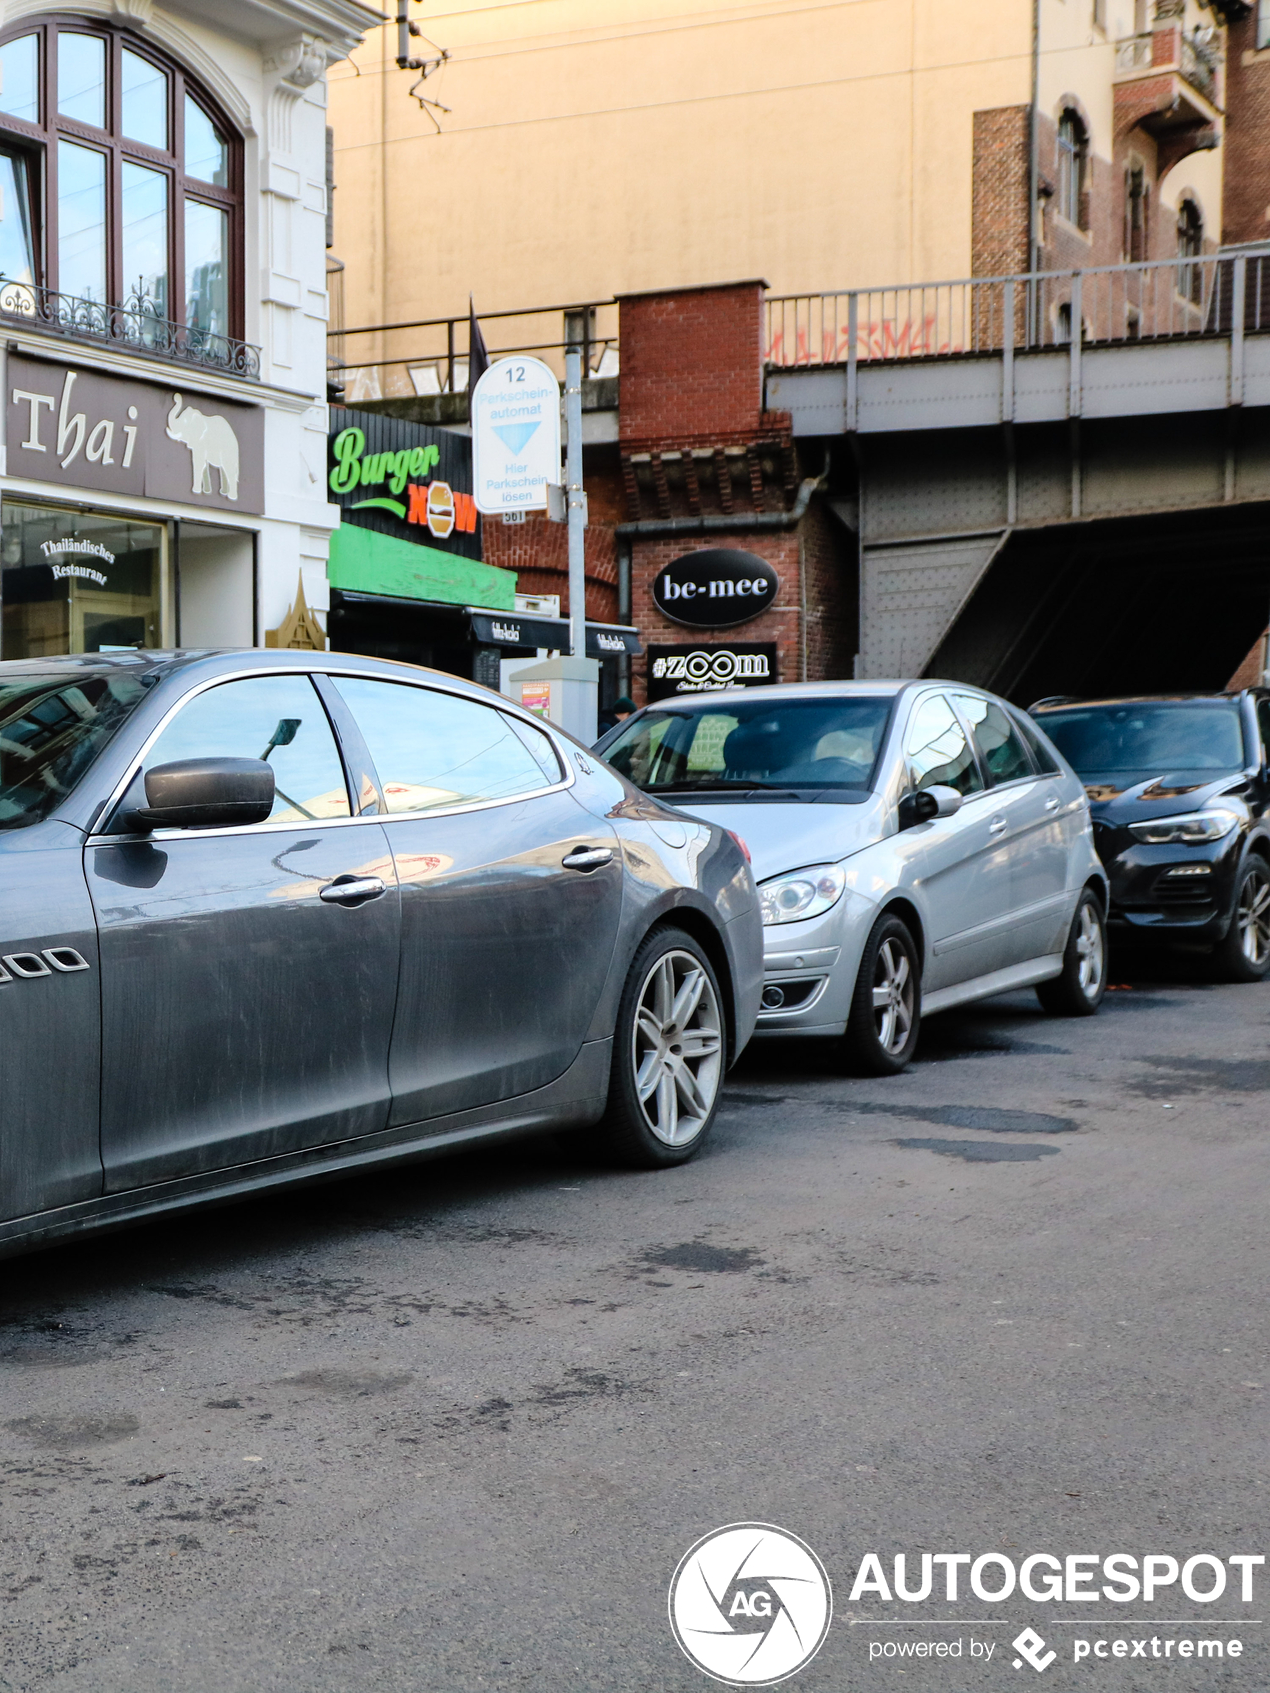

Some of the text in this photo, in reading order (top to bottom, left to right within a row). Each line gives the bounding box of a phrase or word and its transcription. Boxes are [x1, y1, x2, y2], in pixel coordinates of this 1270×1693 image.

[505, 366, 526, 383] 12
[480, 387, 553, 406] Parkschein-
[13, 370, 138, 469] Thai
[490, 402, 542, 419] automat
[329, 426, 440, 495] Burger
[505, 463, 528, 474] Hier
[486, 475, 548, 490] Parkschein
[502, 491, 533, 503] lösen
[40, 538, 116, 564] Thailändisches
[51, 564, 108, 586] Restaurant
[663, 574, 768, 600] be-mee
